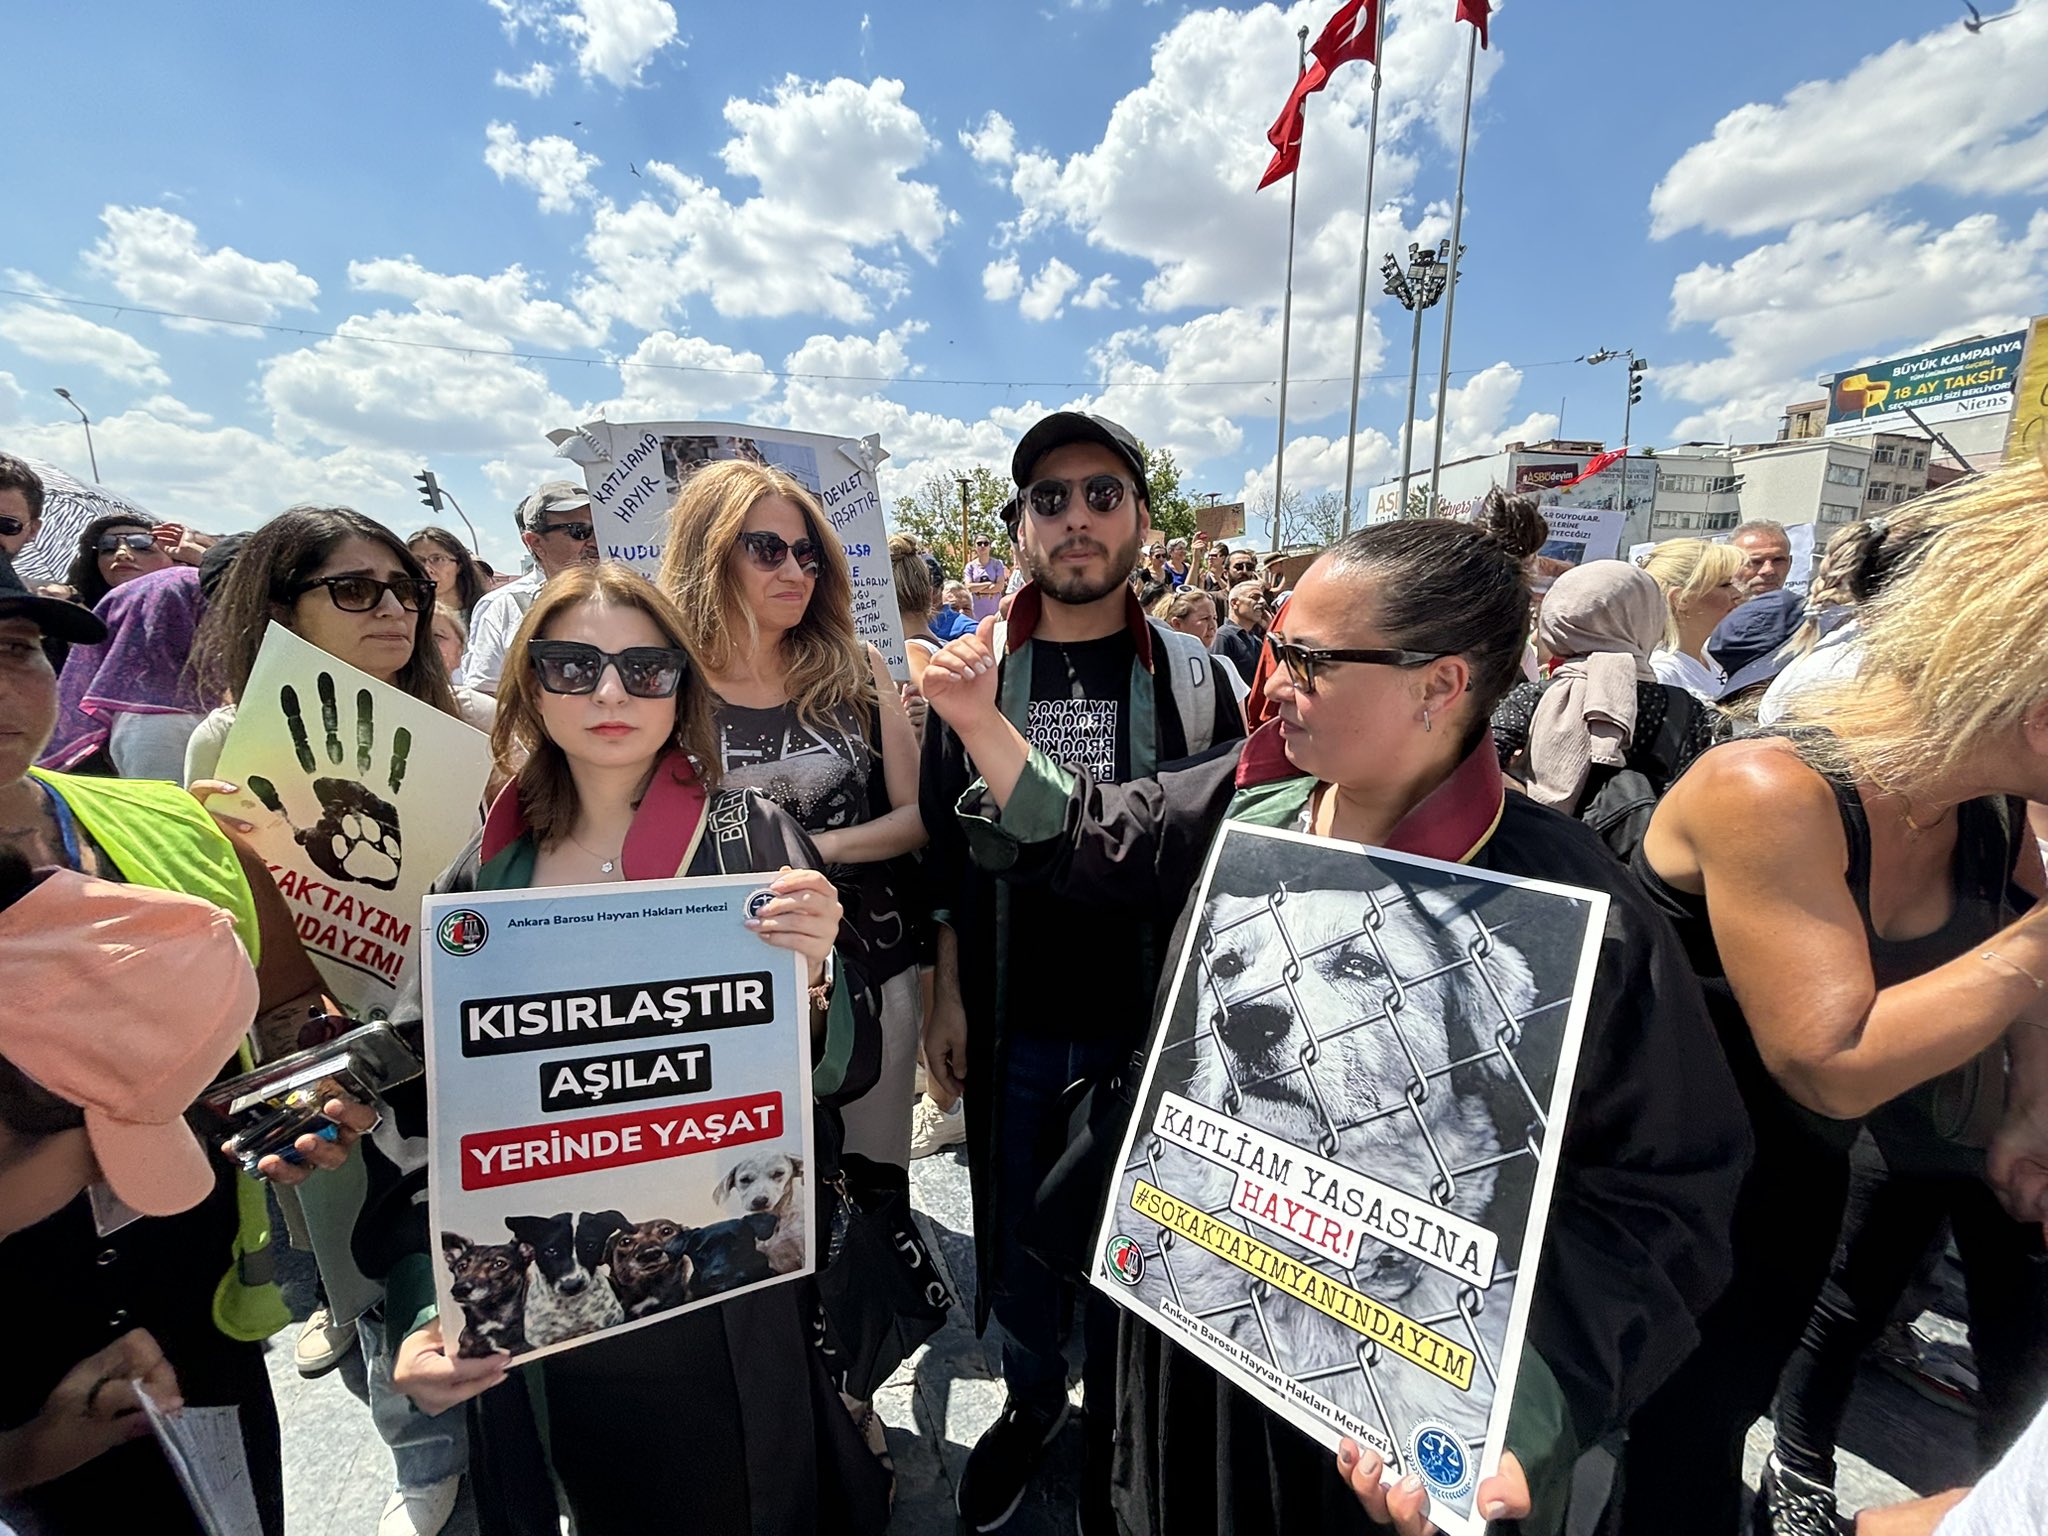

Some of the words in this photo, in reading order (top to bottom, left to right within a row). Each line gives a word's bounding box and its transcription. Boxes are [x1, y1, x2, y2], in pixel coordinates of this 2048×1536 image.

[1892, 358, 1938, 376] BÜYÜK
[1940, 340, 2022, 366] KAMPANYA
[1893, 386, 1912, 400] 18
[1914, 380, 1939, 396] AY
[1944, 366, 2008, 389] TAKSİT
[1944, 389, 1961, 400] SİZİ
[1956, 395, 2008, 413] Niens
[593, 434, 659, 504] KATLİAMA
[824, 470, 862, 506] DEVLET
[613, 475, 660, 524] HAYIR
[826, 491, 878, 532] YAŞATIR
[1550, 521, 1580, 529] LERİNE
[1551, 530, 1592, 539] EYECEĞİZ!
[608, 545, 664, 561] KUDU
[1028, 700, 1117, 716] ROOKLYN
[1026, 726, 1116, 741] ROOKLYN
[268, 865, 412, 947] AKTAYIM
[507, 917, 550, 928] Ankara
[553, 914, 594, 924] Barosu
[597, 910, 640, 922] Hayvan
[642, 907, 683, 918] Hakları
[685, 902, 728, 914] Merkezi
[468, 979, 766, 1042] KISIRLAŞTIR
[548, 1051, 704, 1100] AŞILAT
[469, 1124, 643, 1175] YERİNDE
[650, 1104, 777, 1147] YAŞAT
[1161, 1104, 1294, 1186] KATLİAM
[1302, 1167, 1482, 1276] YASASINA
[1238, 1180, 1356, 1259] HAYIR!
[1136, 1188, 1470, 1381] #SOKAKTAYIMYANINDAYIM
[1162, 1301, 1198, 1331] Ankara
[1200, 1326, 1238, 1357] Barosu
[1240, 1352, 1283, 1386] Hayvan
[1286, 1380, 1331, 1417] Hakları
[1334, 1410, 1388, 1452] Merkezi
